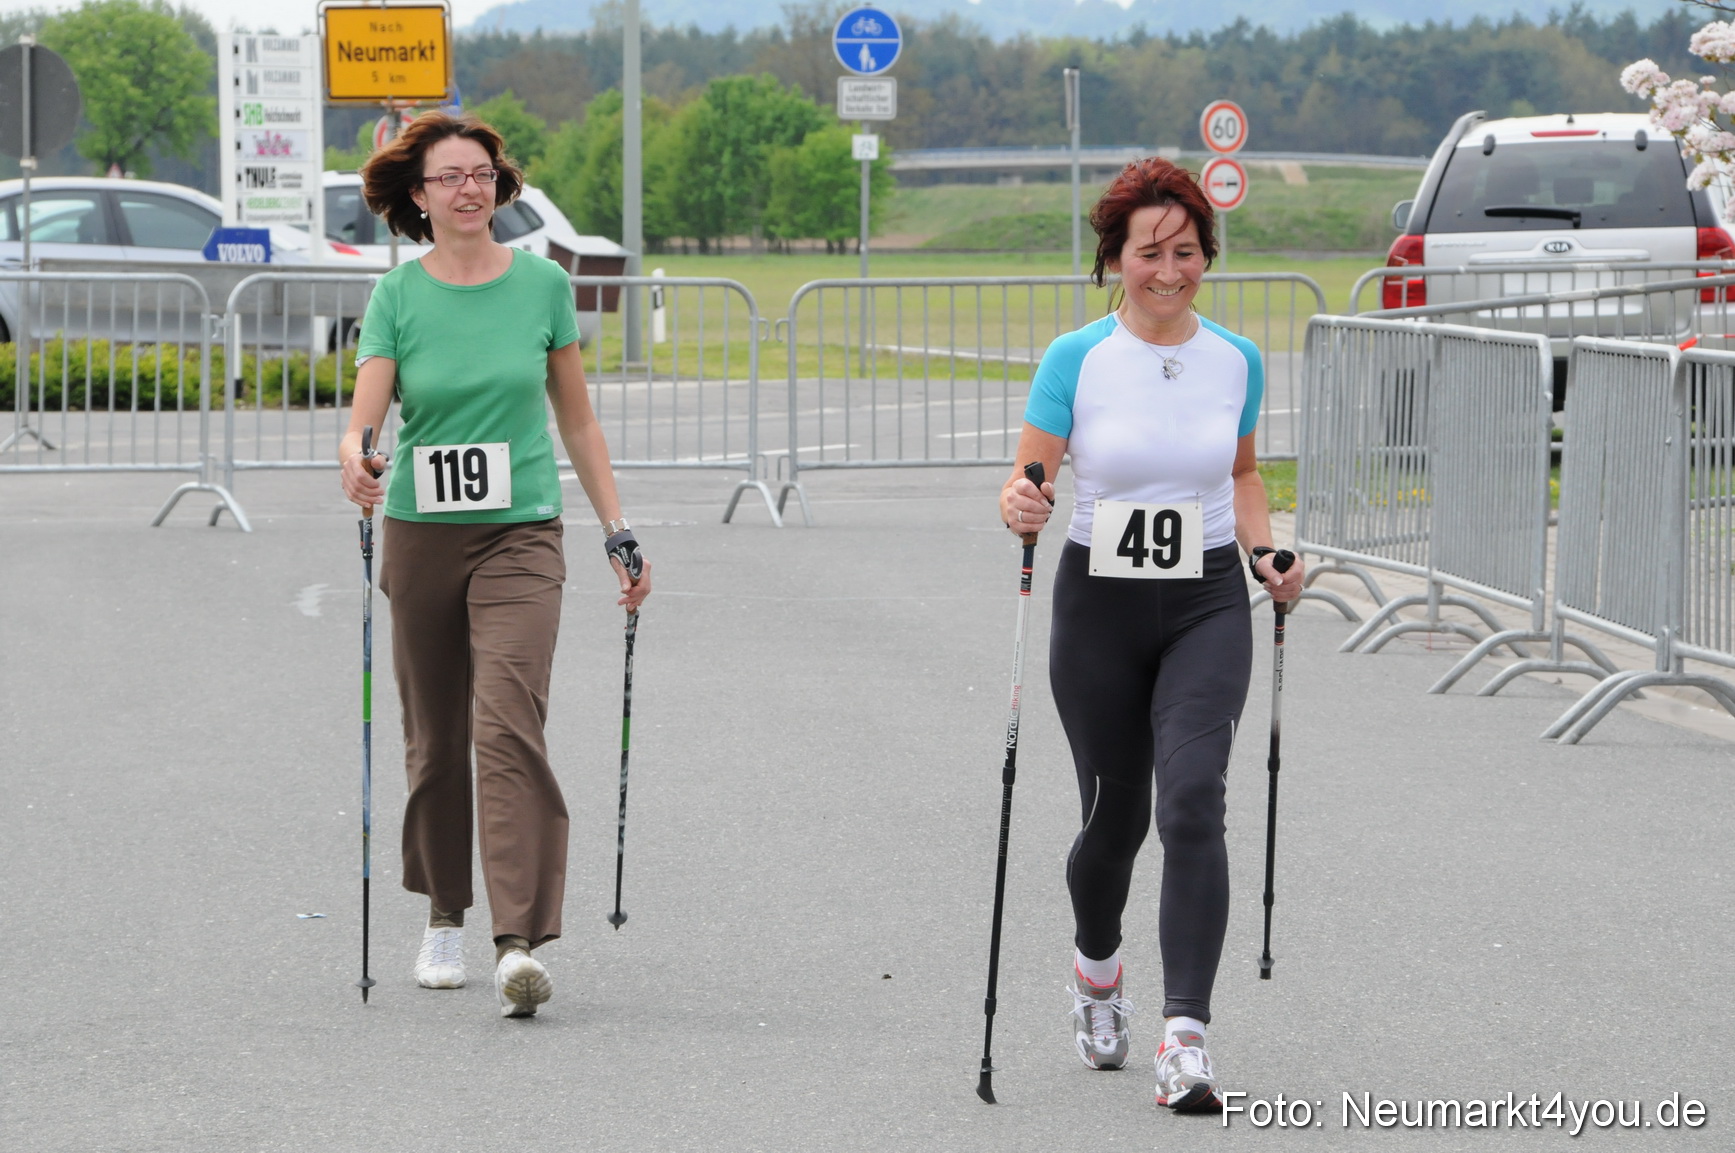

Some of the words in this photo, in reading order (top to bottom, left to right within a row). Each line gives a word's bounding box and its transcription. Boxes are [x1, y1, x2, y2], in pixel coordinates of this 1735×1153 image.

[369, 21, 403, 32] Nach
[337, 40, 436, 62] Neumarkt
[371, 71, 379, 82] 5
[389, 72, 406, 83] km
[1212, 116, 1238, 139] 60
[217, 243, 266, 263] VOLVO
[1545, 241, 1571, 252] KIA
[428, 447, 489, 503] 119
[1116, 508, 1183, 570] 49
[1011, 684, 1021, 710] Hiking
[1006, 709, 1018, 749] Nordic
